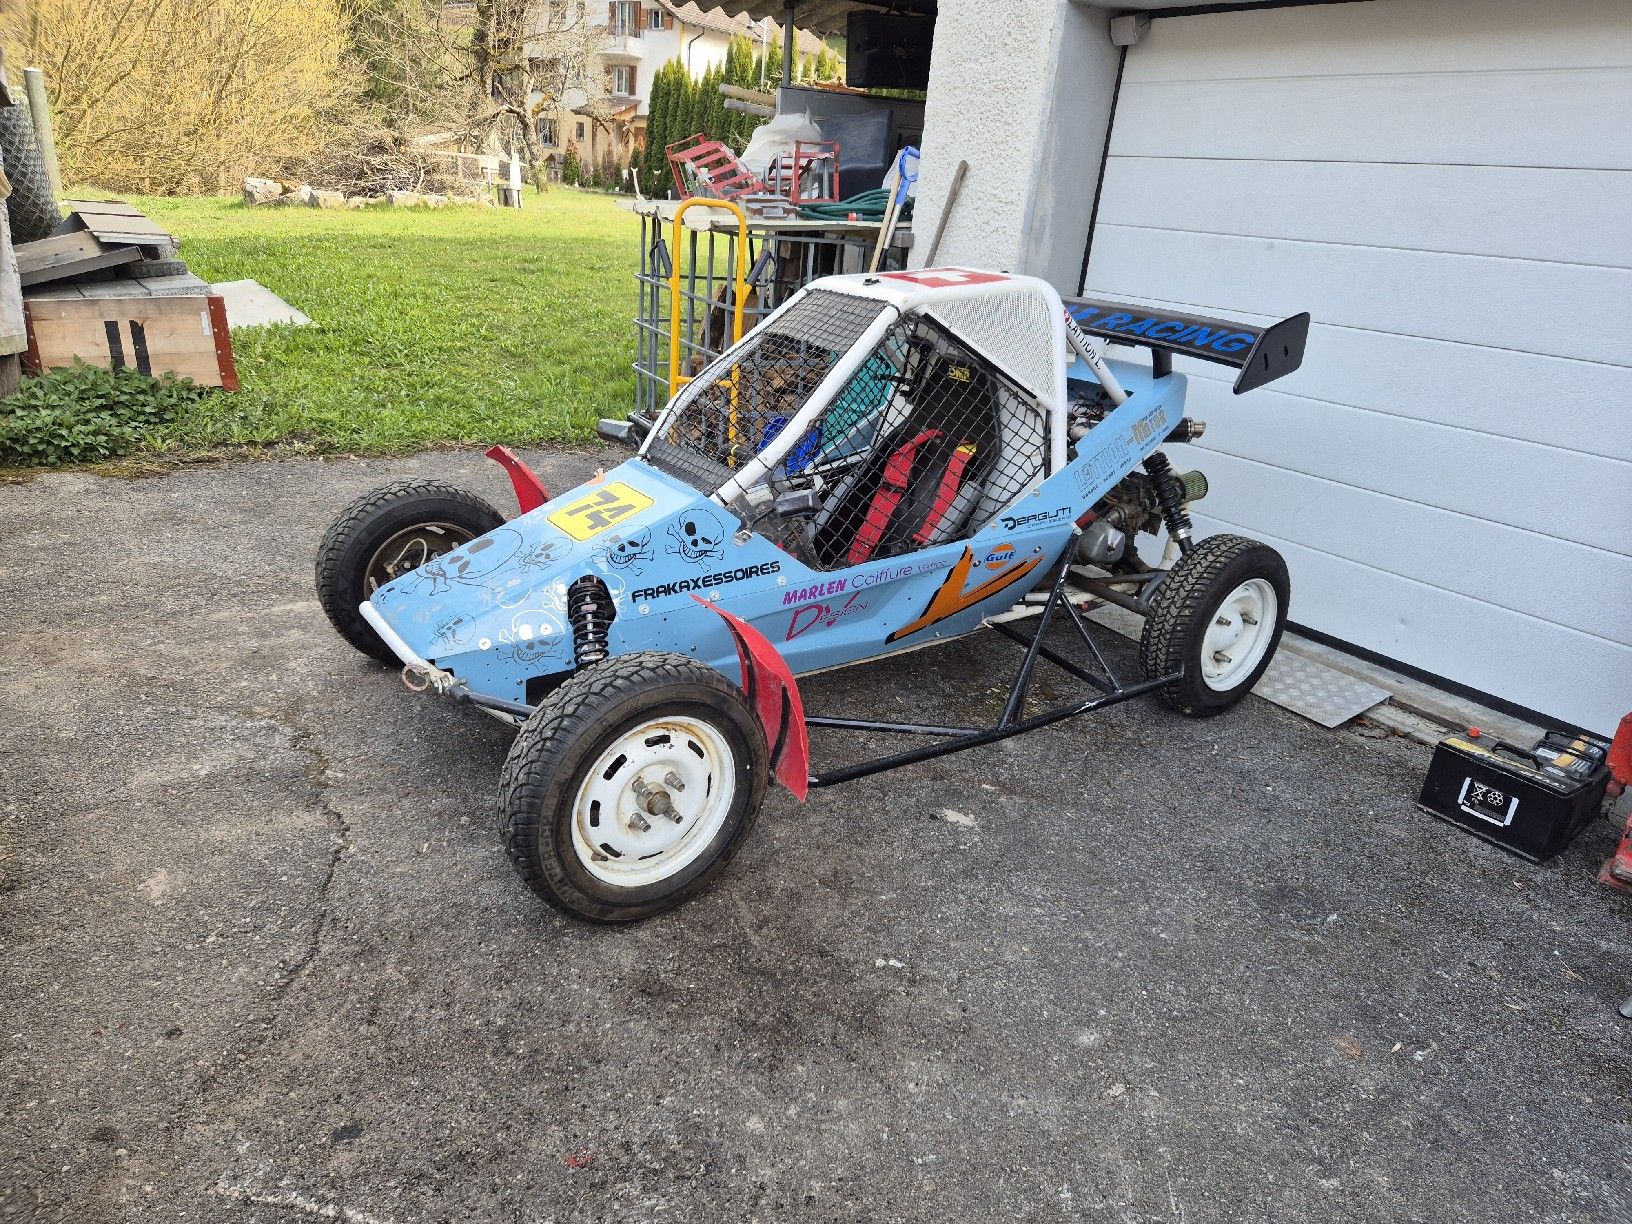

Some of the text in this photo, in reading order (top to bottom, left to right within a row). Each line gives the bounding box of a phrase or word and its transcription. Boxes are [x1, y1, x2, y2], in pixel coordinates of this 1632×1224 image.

[1067, 319, 1097, 359] LATTION
[1091, 312, 1255, 352] RACING
[565, 490, 636, 530] 74
[984, 551, 1016, 562] Gulf
[631, 560, 781, 603] FRAKAXESSOIRES
[783, 578, 848, 605] MARLEN
[851, 564, 913, 589] Coiffure
